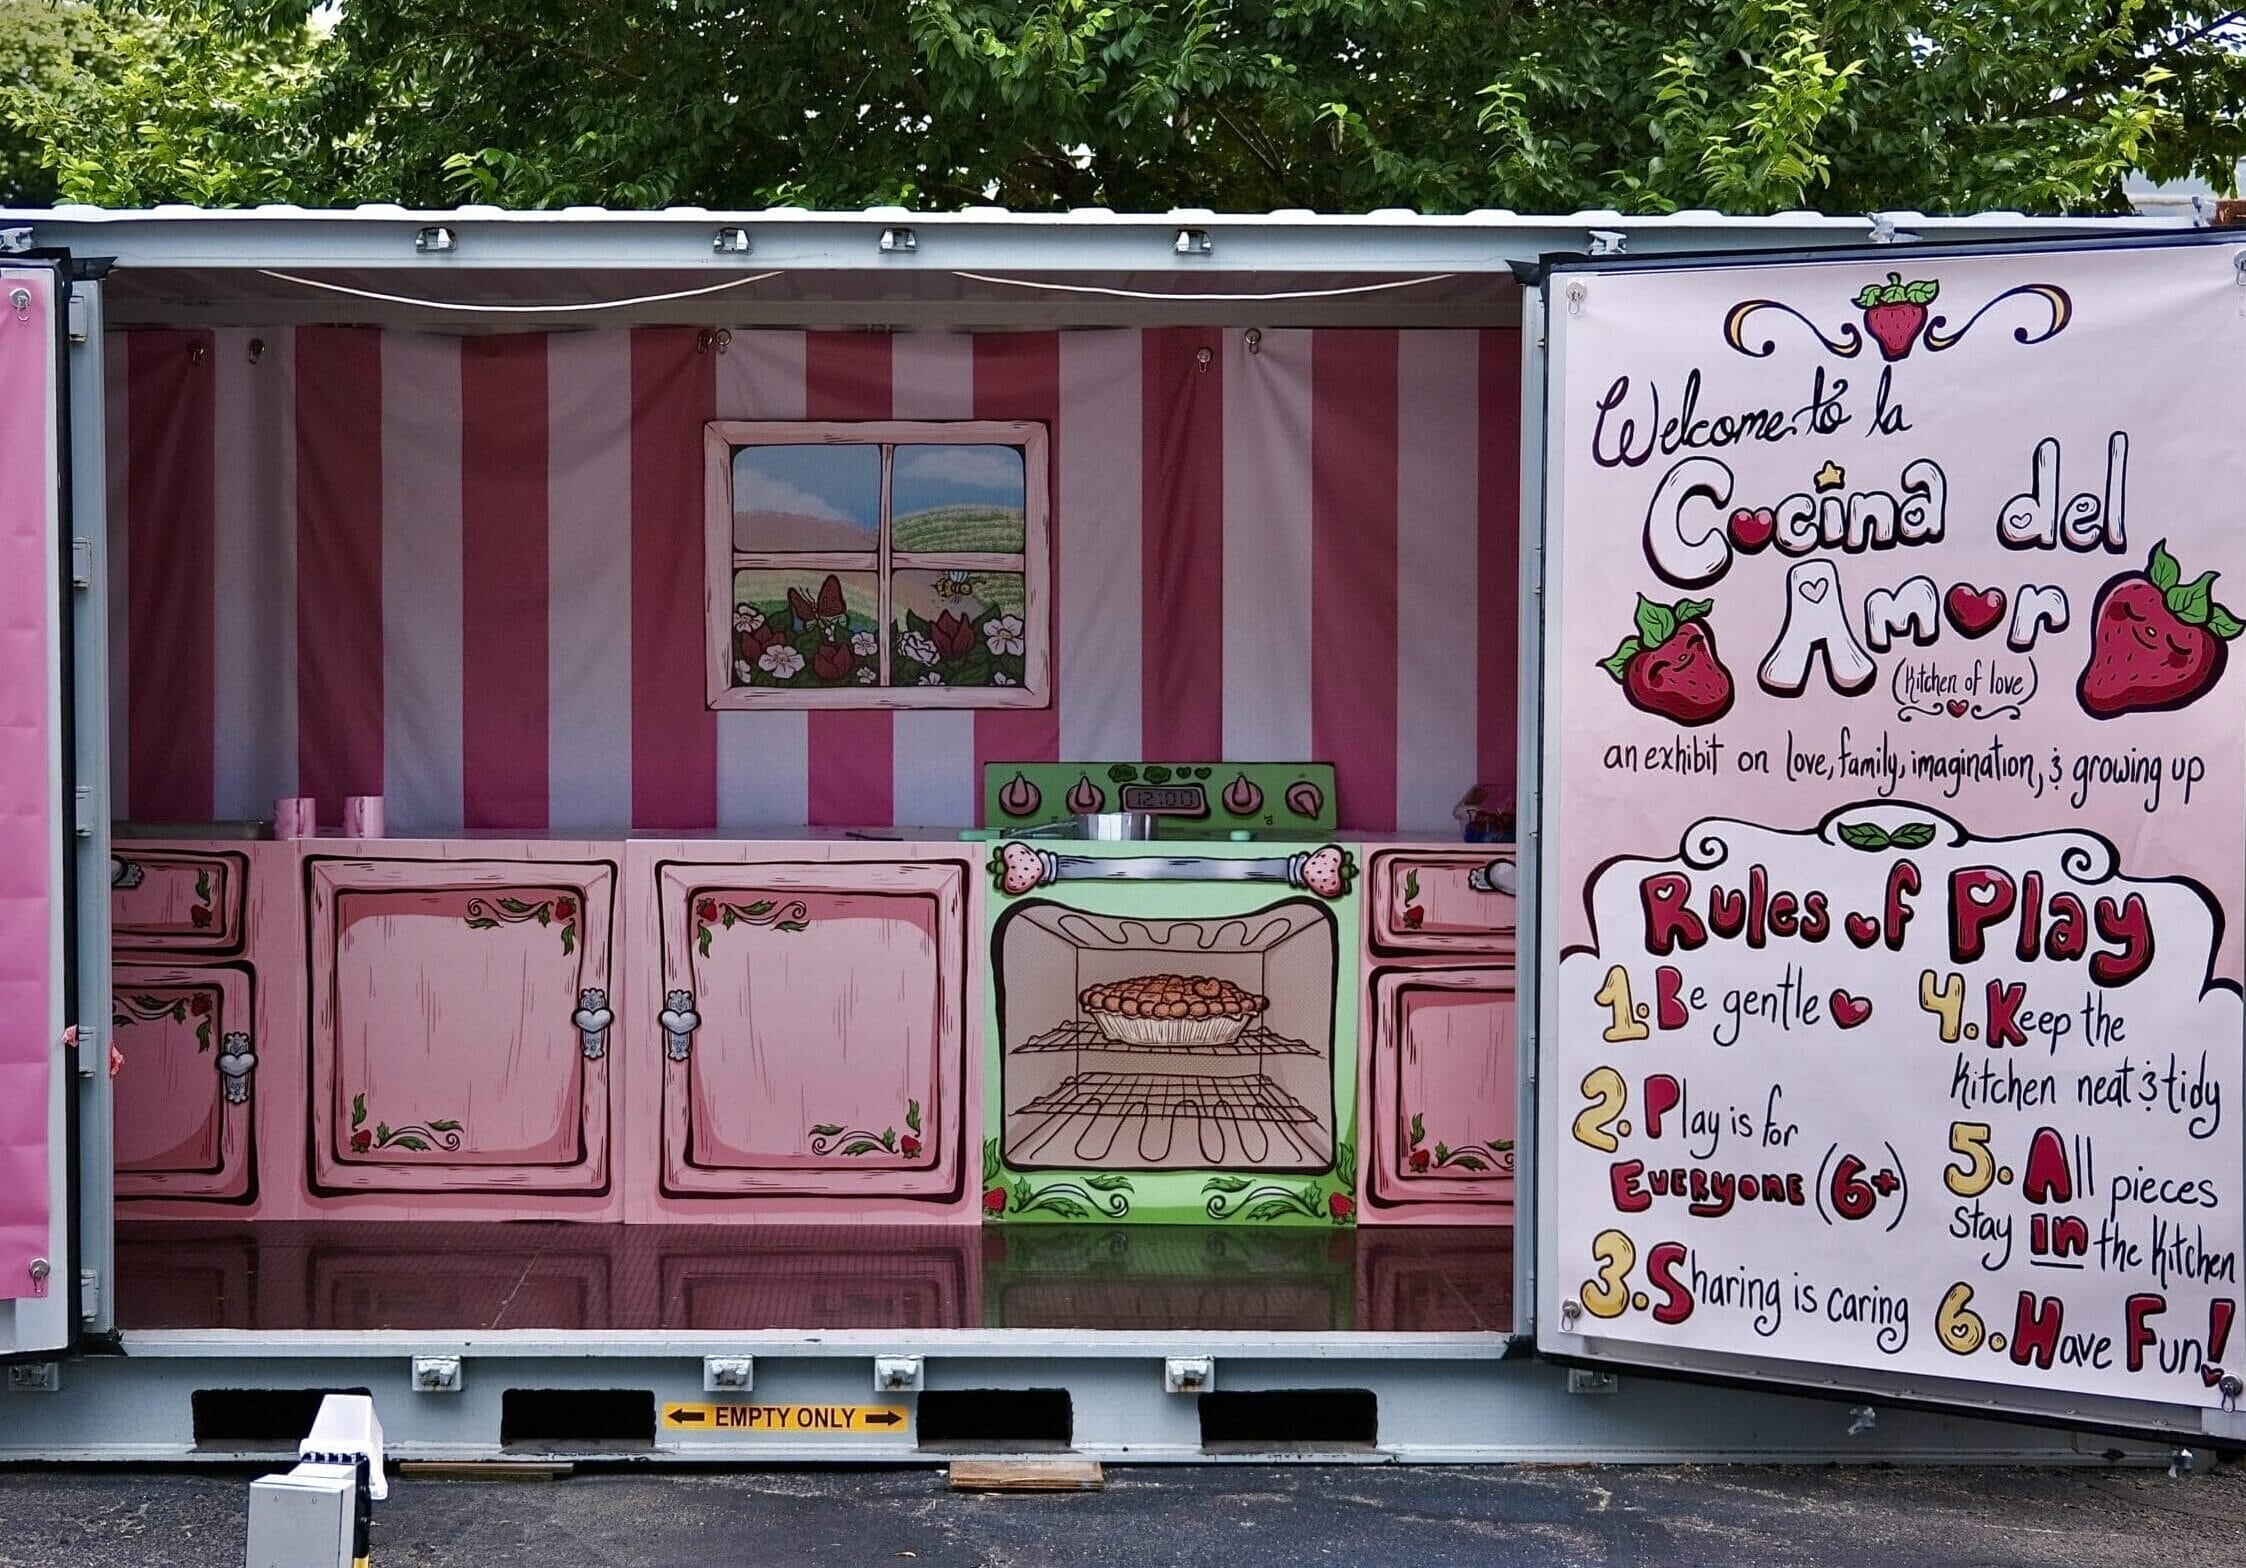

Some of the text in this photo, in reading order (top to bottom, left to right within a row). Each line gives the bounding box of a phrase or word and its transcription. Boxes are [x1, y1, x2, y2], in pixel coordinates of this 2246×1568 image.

[1592, 364, 1912, 467] Welcome to la
[1643, 431, 2128, 589] Cocina del
[1757, 558, 2070, 698] Amor
[1964, 659, 1983, 696] of
[1990, 656, 2038, 705] love)
[1604, 745, 1637, 772] an
[1645, 733, 1724, 776] exhibit
[1738, 750, 1769, 773] on
[1786, 730, 1833, 782] love,
[1838, 726, 1905, 797] family,
[1911, 734, 2043, 798] imagination,
[2071, 747, 2162, 812] growing
[2172, 756, 2205, 804] up
[1639, 858, 2156, 988] Rules of Play
[1656, 966, 1707, 1030] Be
[1713, 962, 1820, 1047] gentle
[1986, 978, 2071, 1056] Keep
[2080, 990, 2125, 1047] the
[1644, 1074, 1719, 1160] Play
[1729, 1106, 1753, 1137] is
[1763, 1084, 1798, 1147] for
[2077, 1056, 2134, 1107] neat
[2162, 1050, 2220, 1139] tidy
[1816, 1141, 1907, 1232] (6+)
[2023, 1127, 2094, 1204] All
[2111, 1165, 2218, 1222] pieces
[2093, 1218, 2142, 1272] the
[1647, 1241, 1781, 1337] Sharing
[1793, 1272, 1817, 1313] is
[1827, 1286, 1909, 1354] caring
[2010, 1291, 2112, 1370] Have
[2126, 1293, 2236, 1387] Fun!
[715, 1406, 856, 1429] EMPTY ONLY
